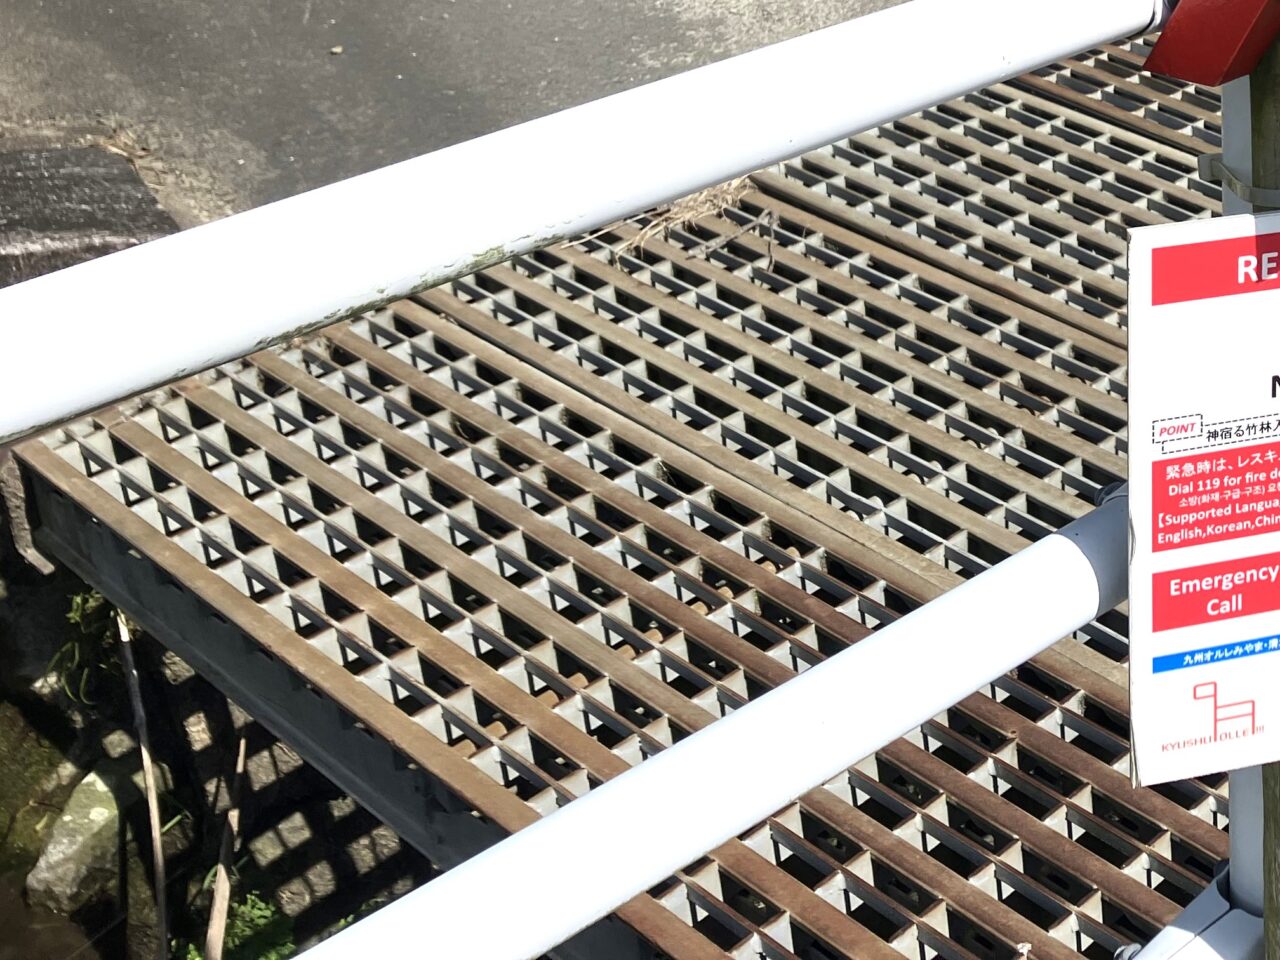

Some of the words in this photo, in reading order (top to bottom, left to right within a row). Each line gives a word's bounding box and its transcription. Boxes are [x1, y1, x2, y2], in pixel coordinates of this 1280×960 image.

[1159, 422, 1197, 437] POINT
[1168, 480, 1194, 496] Dial
[1197, 477, 1220, 491] 119
[1223, 474, 1242, 487] for
[1245, 471, 1267, 484] fire
[1170, 565, 1280, 596] Emergency
[1207, 594, 1243, 616] Call
[1162, 735, 1212, 752] KYUSHU
[1220, 728, 1250, 742] OLLE
